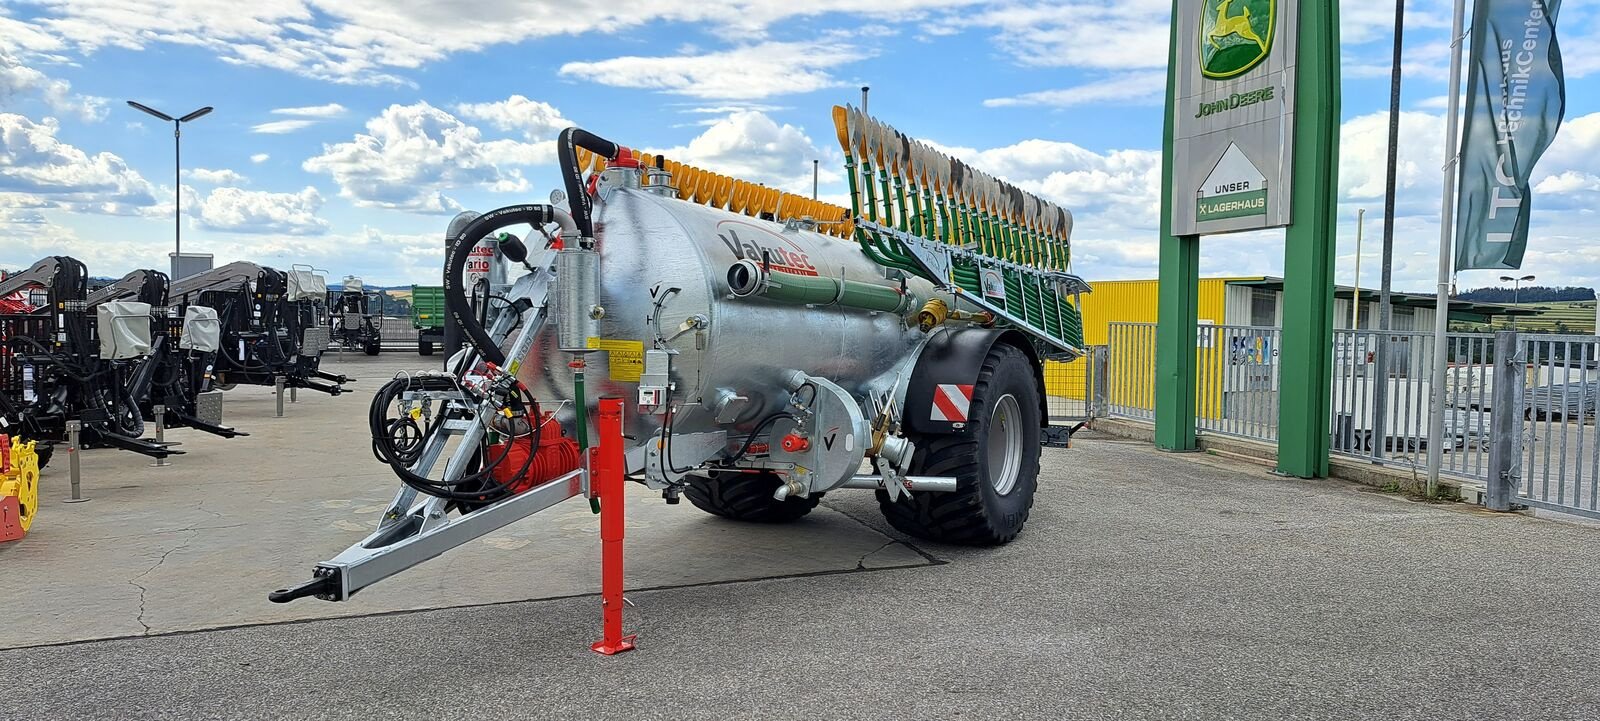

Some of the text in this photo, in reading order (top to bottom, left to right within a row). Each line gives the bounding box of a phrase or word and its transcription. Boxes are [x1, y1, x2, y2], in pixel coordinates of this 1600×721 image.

[1195, 86, 1274, 118] JOHN DEERE
[1215, 181, 1250, 194] UNSER
[1208, 198, 1265, 213] LAGERHAUS
[717, 229, 815, 270] Vakutec
[468, 258, 489, 269] ario
